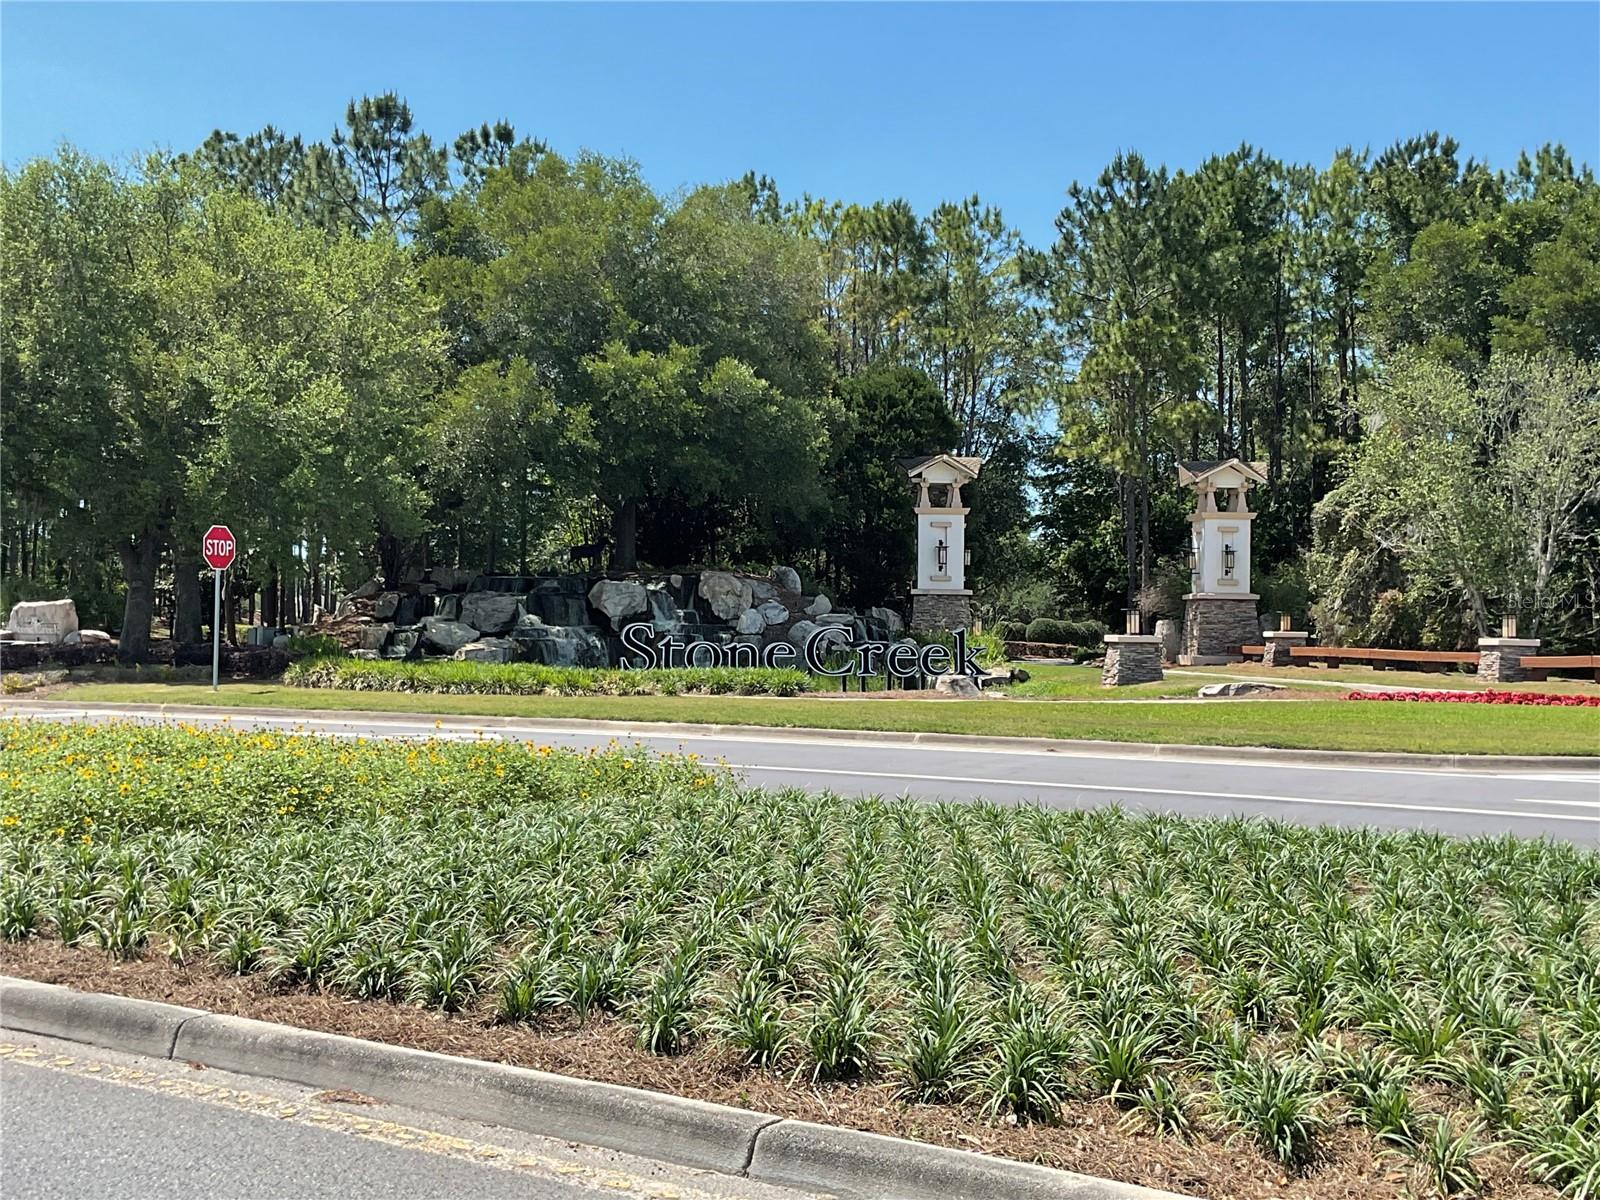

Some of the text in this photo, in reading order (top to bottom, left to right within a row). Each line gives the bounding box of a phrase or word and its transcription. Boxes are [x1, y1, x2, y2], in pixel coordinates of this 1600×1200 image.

[205, 540, 233, 556] STOP
[619, 622, 992, 678] Stone Creek
